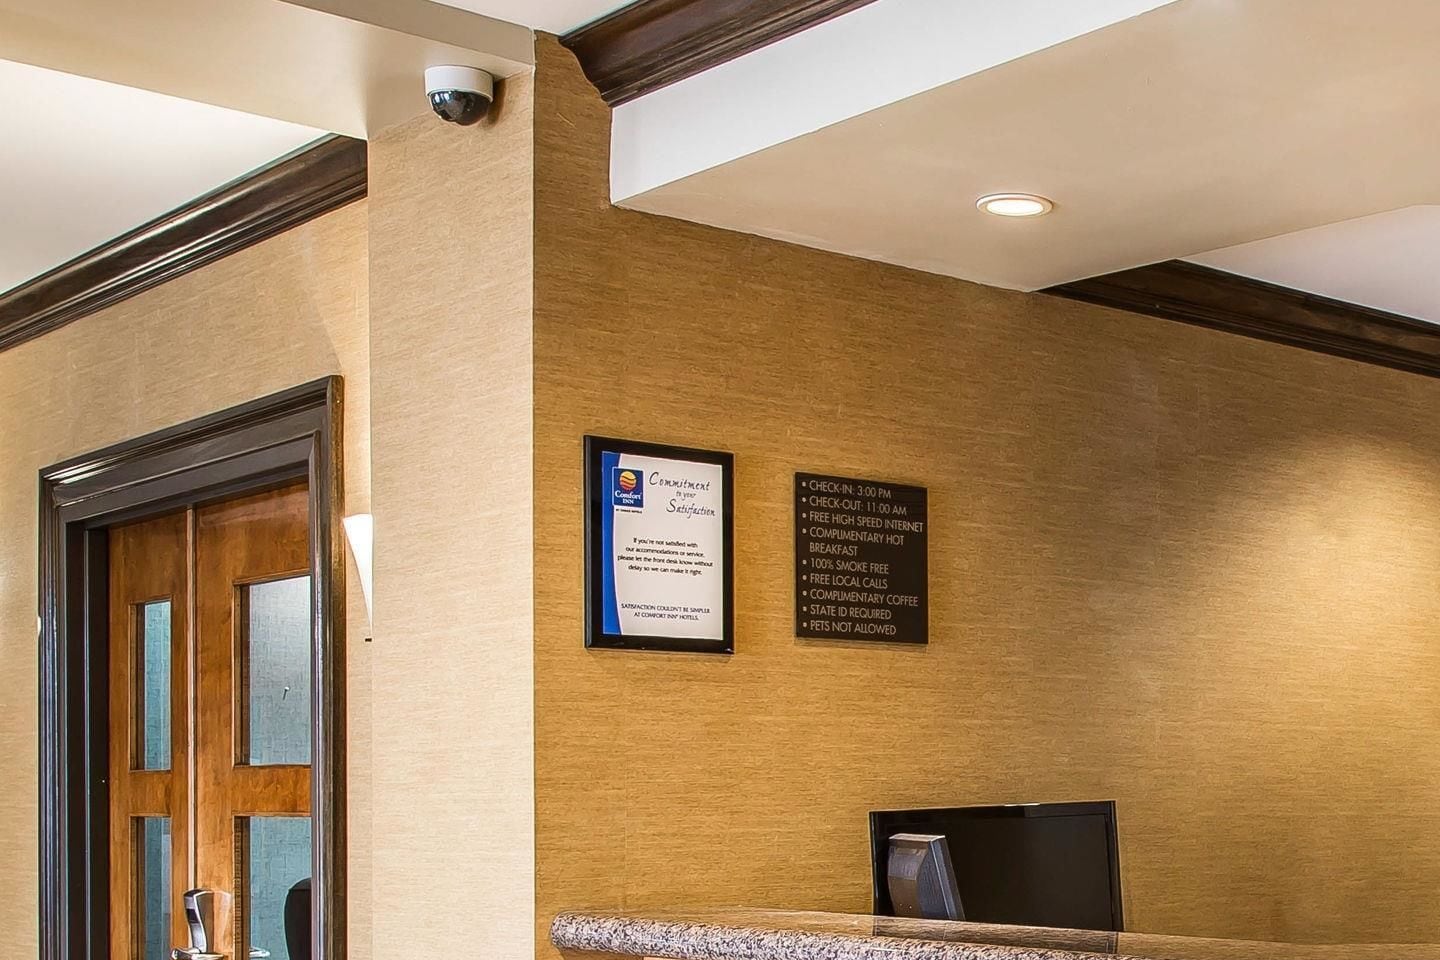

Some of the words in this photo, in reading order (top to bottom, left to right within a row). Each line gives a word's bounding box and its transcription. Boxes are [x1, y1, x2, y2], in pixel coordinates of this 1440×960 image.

[649, 472, 710, 491] Commitment
[809, 480, 855, 496] CHECK-IN:
[858, 485, 876, 497] 3:00
[879, 488, 892, 499] PM
[615, 490, 641, 500] Comfort
[683, 492, 696, 500] your
[666, 499, 715, 519] Satisfaction
[809, 496, 863, 511] CHECK-OUT:
[867, 501, 890, 514] 11:00
[892, 505, 907, 515] AM
[809, 511, 829, 523] FREE
[832, 513, 854, 526] HIGH
[857, 516, 883, 528] SPEED
[884, 519, 923, 533] INTERNET
[809, 527, 884, 543] COMPLIMENTARY
[886, 533, 904, 546] HOT
[809, 542, 858, 556] BREAKFAST
[810, 557, 834, 569] 100%
[836, 560, 868, 572] SMOKE
[870, 563, 889, 574] FREE
[810, 573, 830, 585] FREE
[832, 575, 860, 588] LOCAL
[862, 577, 888, 589] CALLS
[809, 588, 884, 604] COMPLIMENTARY
[887, 595, 919, 606] COFFEE
[810, 604, 836, 616] STATE
[838, 606, 847, 617] ID
[849, 607, 892, 620] REQUIRED
[810, 620, 829, 632] PETS
[832, 622, 852, 633] NOT
[854, 623, 896, 635] ALLOWED
